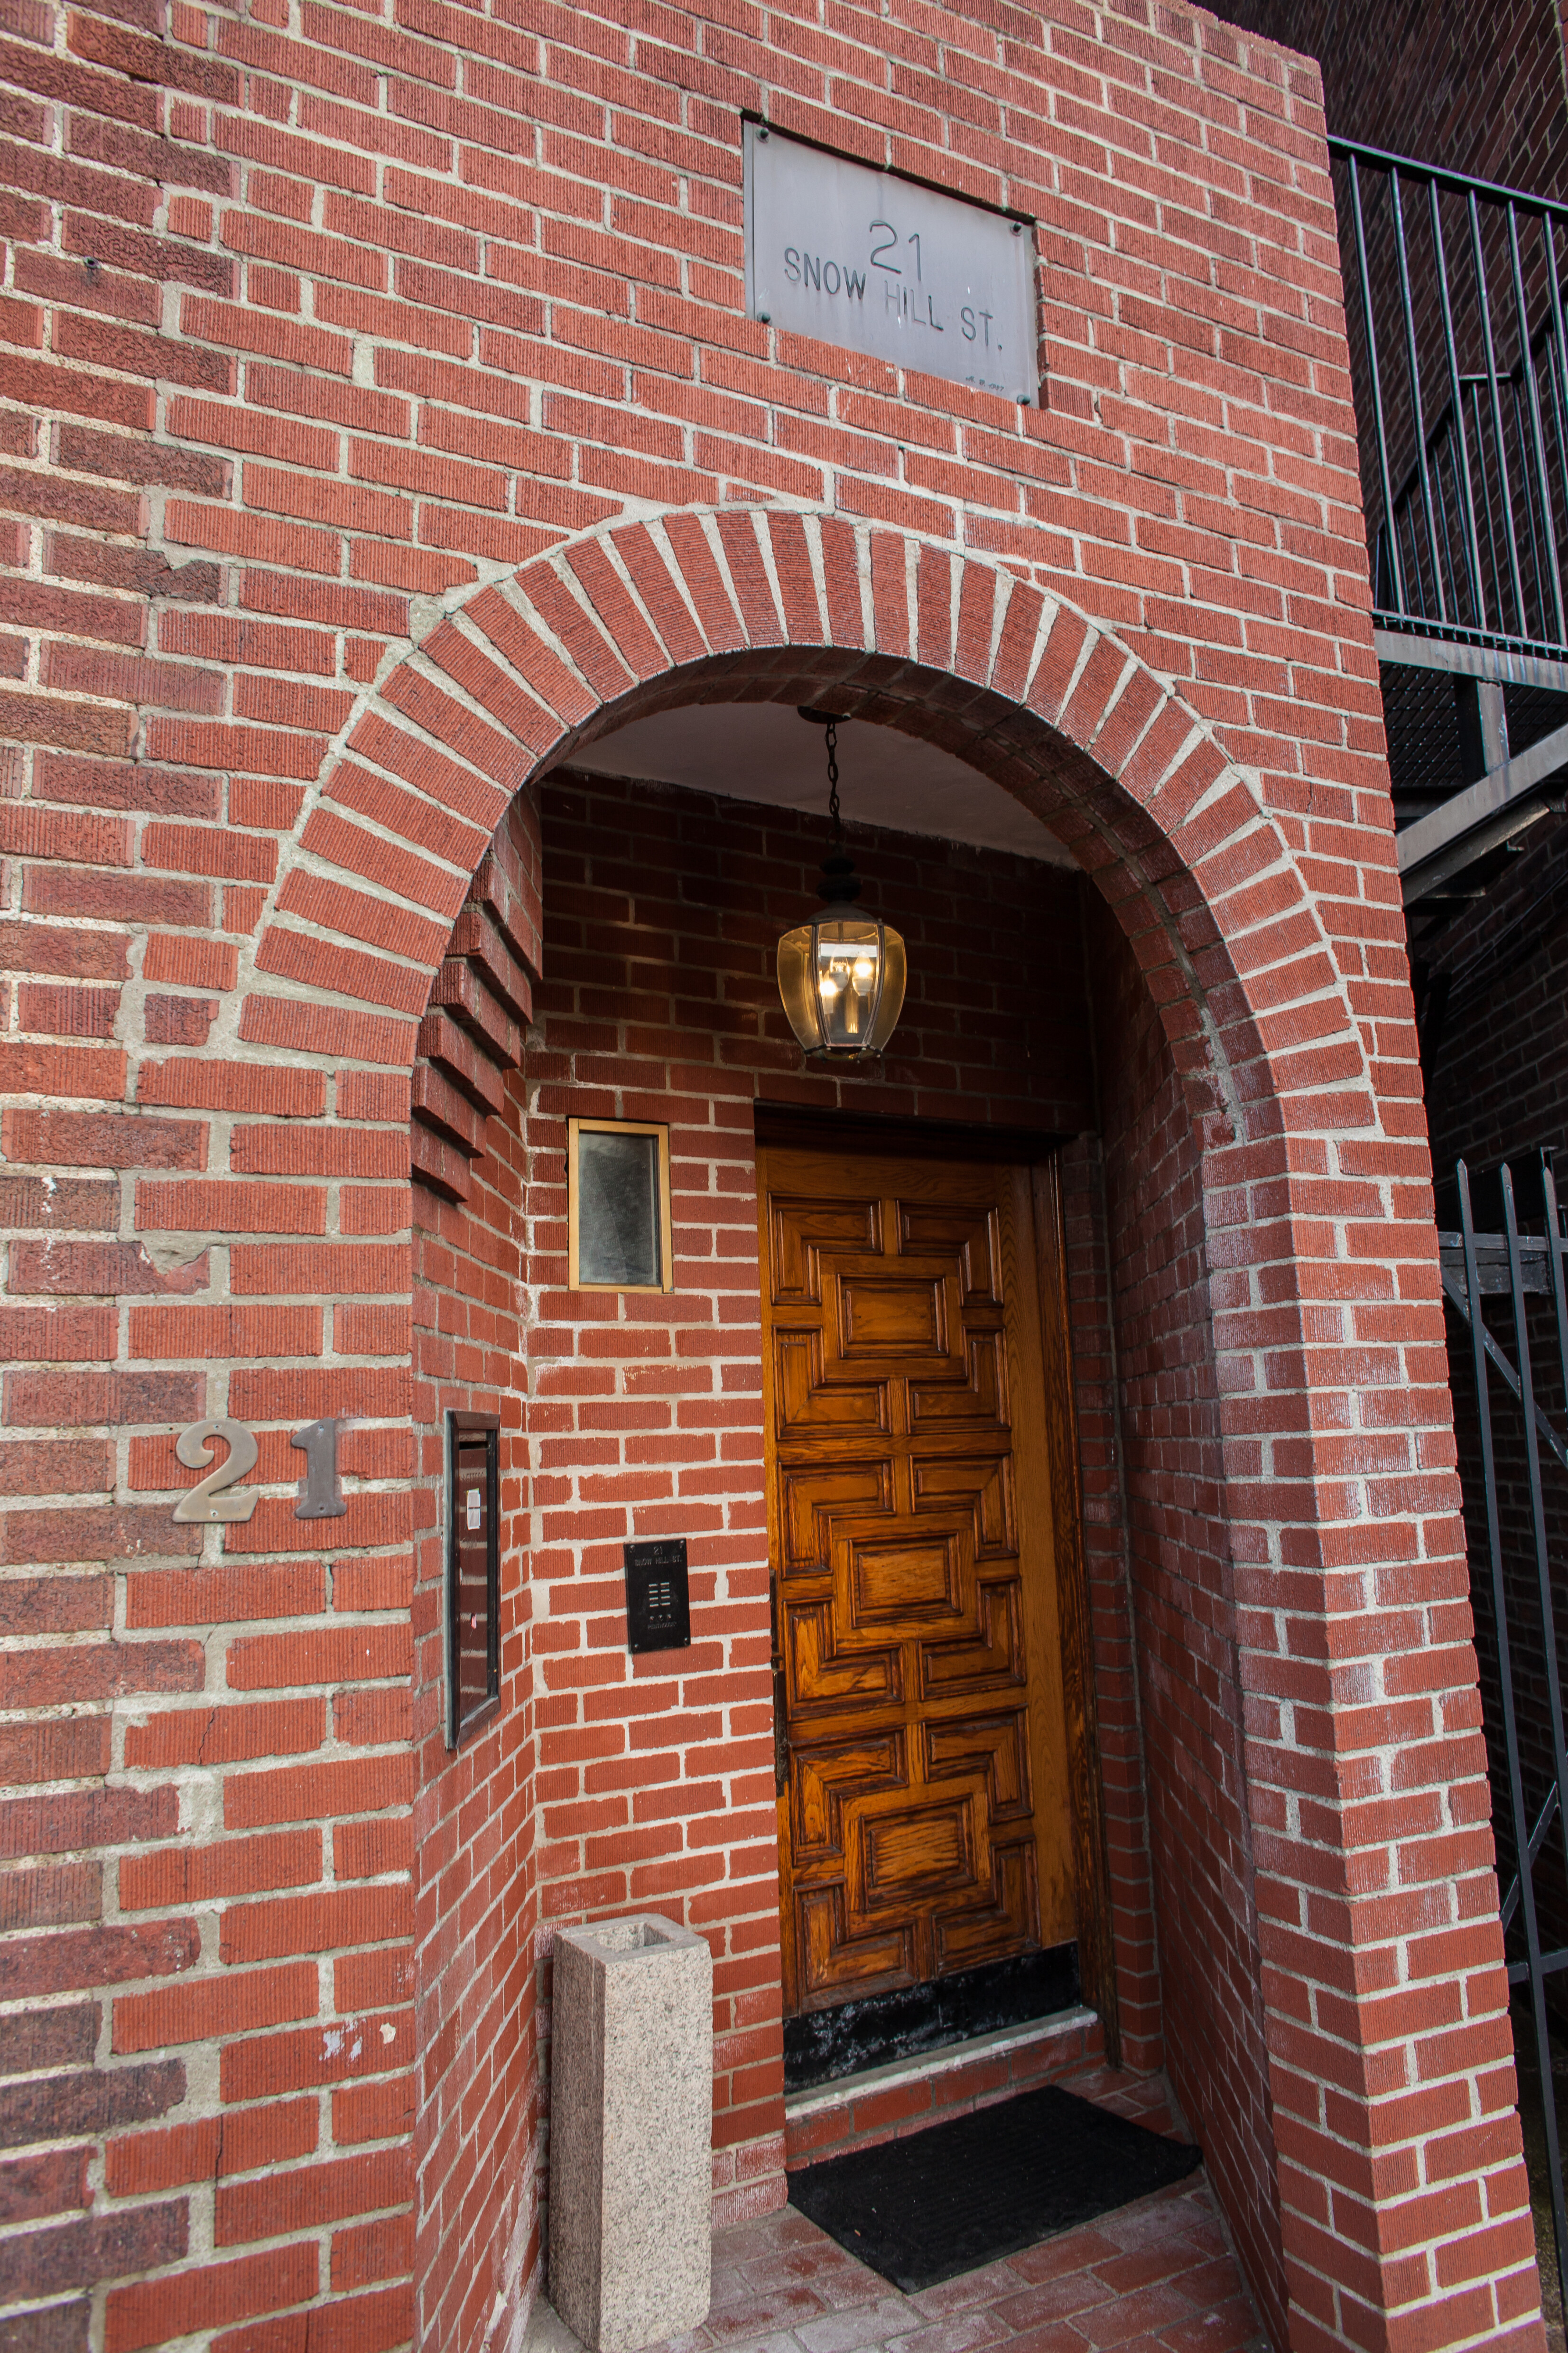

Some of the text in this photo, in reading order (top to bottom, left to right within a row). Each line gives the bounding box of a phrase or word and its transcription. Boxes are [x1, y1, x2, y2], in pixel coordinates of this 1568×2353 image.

[870, 220, 922, 281] 21
[784, 248, 1002, 351] SNOW HILL ST.
[172, 1417, 347, 1523] 21
[654, 1546, 663, 1555] 21
